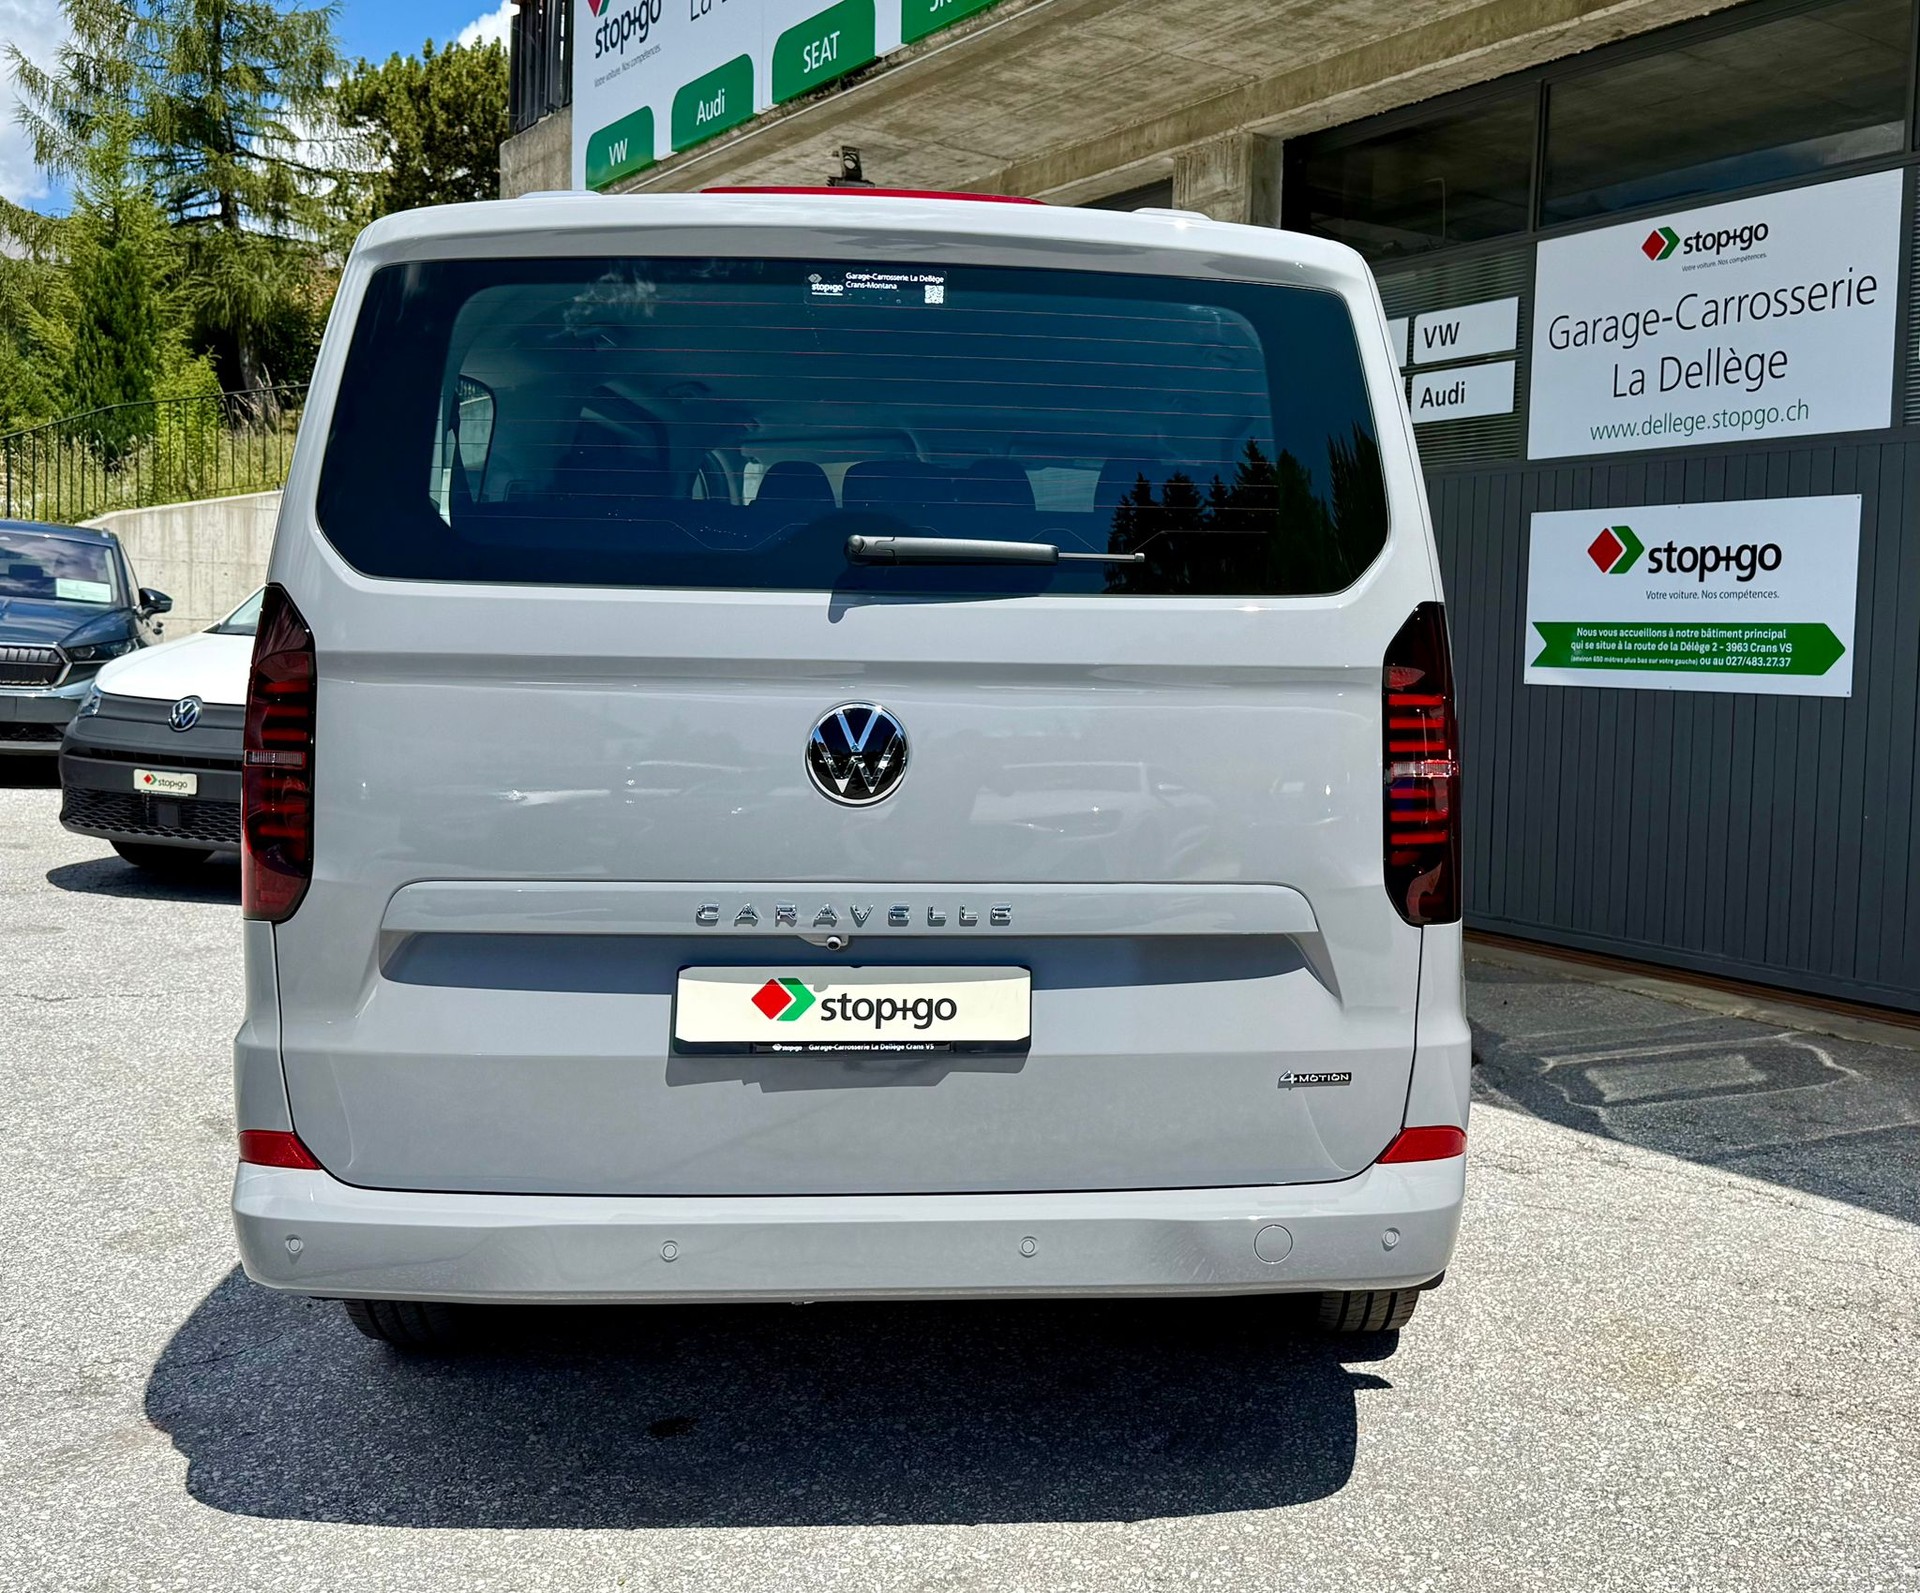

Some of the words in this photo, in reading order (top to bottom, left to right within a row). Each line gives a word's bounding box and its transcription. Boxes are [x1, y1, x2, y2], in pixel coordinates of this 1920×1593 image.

[595, 0, 661, 59] stop+go
[803, 31, 840, 73] SEAT
[696, 88, 725, 126] Audi
[609, 138, 628, 167] VW
[1683, 223, 1769, 255] stop+go
[845, 272, 909, 282] Garage-Carrosserie
[845, 281, 898, 290] Crans-Montana
[1549, 266, 1878, 350] Garage-Carrosserie
[1423, 321, 1460, 349] VW
[1612, 362, 1646, 398] La
[1659, 346, 1789, 393] Dellège
[1420, 380, 1466, 409] Audi
[1590, 399, 1810, 441] www.dellege.stopgo.ch
[1648, 540, 1782, 582] stop+go
[1646, 590, 1667, 600] Votre
[1668, 590, 1700, 600] voiture.
[1701, 590, 1718, 600] Nos
[1719, 589, 1780, 601] compétences.
[1571, 641, 1584, 651] qui
[1596, 641, 1617, 650] situe
[1618, 640, 1623, 650] à
[1625, 641, 1632, 650] la
[1634, 642, 1656, 651] route
[1658, 642, 1668, 651] de
[1671, 642, 1678, 651] la
[1712, 642, 1717, 652] 2
[1726, 643, 1748, 652] 3963
[1750, 643, 1777, 653] Crans
[1779, 643, 1792, 653] VS
[1577, 628, 1597, 637] Nous
[1599, 629, 1618, 637] vous
[1619, 628, 1667, 637] accueillons
[1669, 628, 1674, 637] à
[1676, 629, 1699, 638] notre
[1701, 628, 1743, 638] bâtiment
[1744, 629, 1787, 640] principal
[1713, 658, 1724, 666] au
[1726, 656, 1791, 667] 027/483.27.37
[696, 903, 1013, 928] CARAVELLE
[821, 993, 957, 1029] stop+go
[1280, 1070, 1350, 1084] 4MOTION
